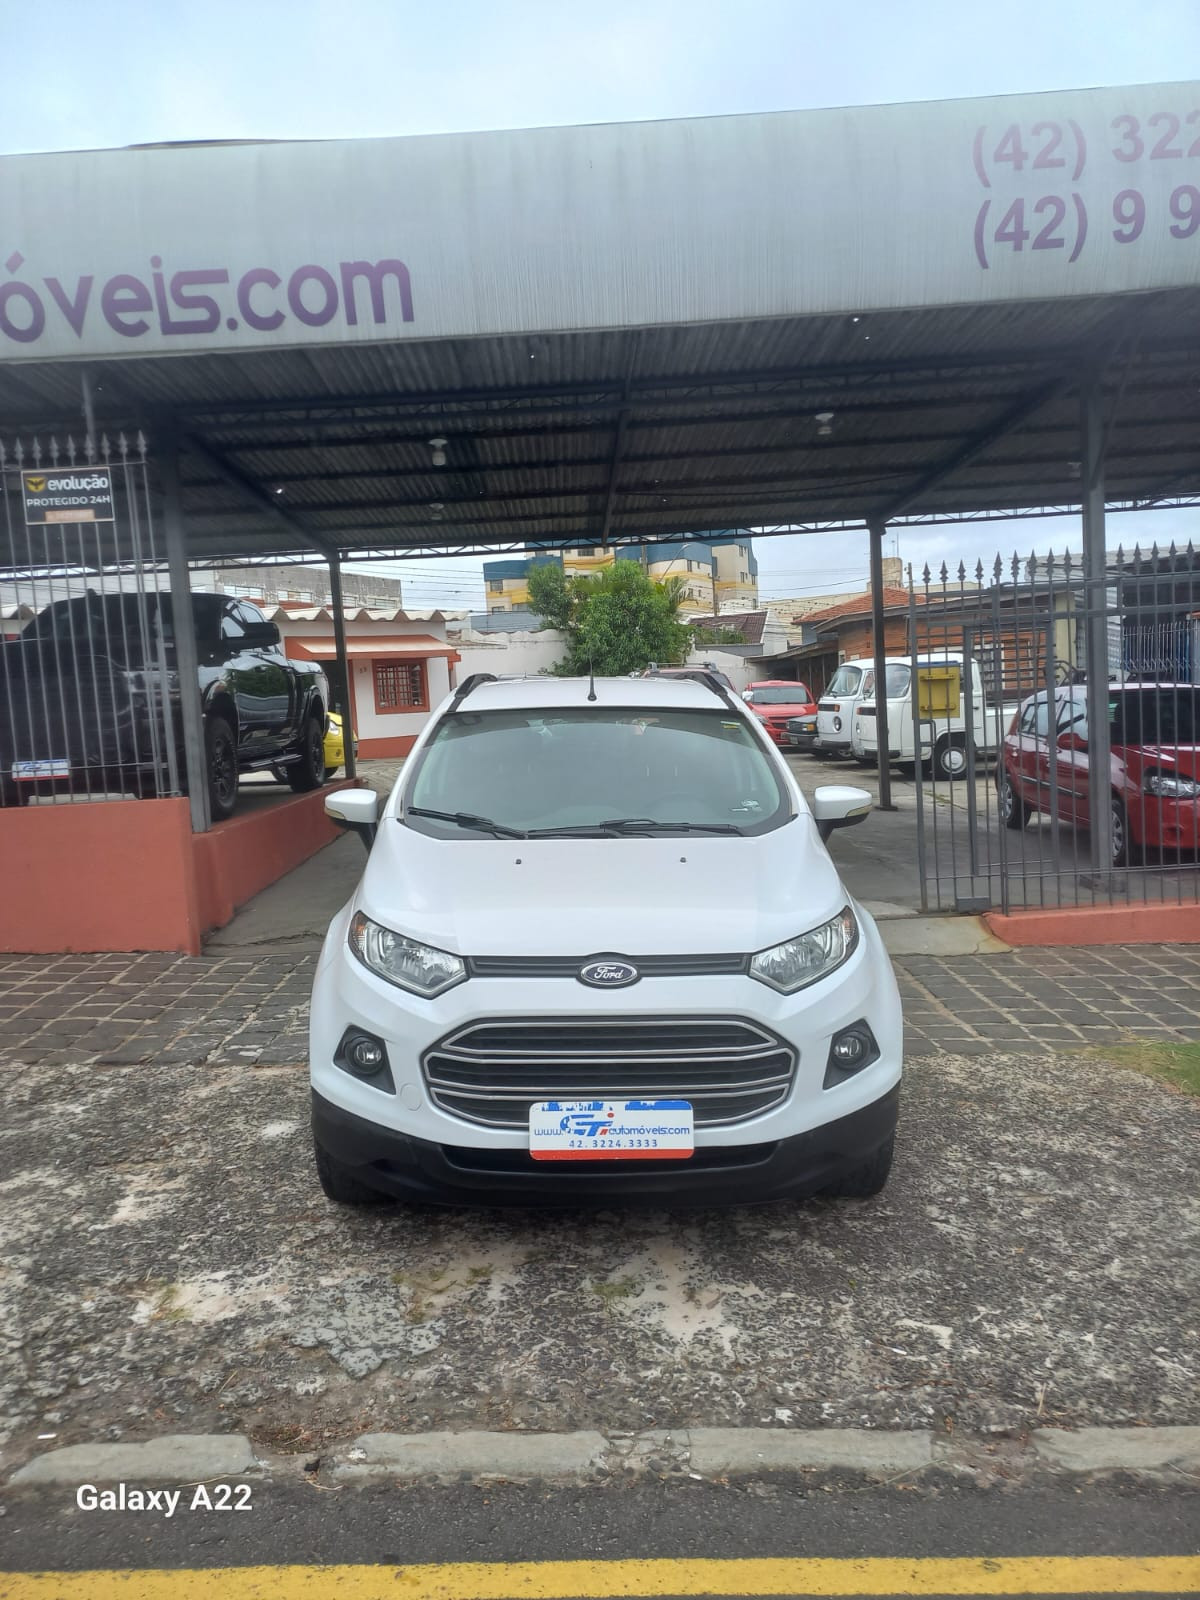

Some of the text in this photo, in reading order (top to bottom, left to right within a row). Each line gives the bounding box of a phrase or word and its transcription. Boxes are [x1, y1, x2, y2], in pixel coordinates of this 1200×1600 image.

[972, 119, 1087, 188] (42)
[974, 185, 1200, 269] (42) 9 9
[47, 474, 109, 491] evolução
[27, 495, 111, 507] PROTEGIDO 24H
[594, 966, 624, 979] Ford
[569, 1139, 658, 1149] 42.3224.3333
